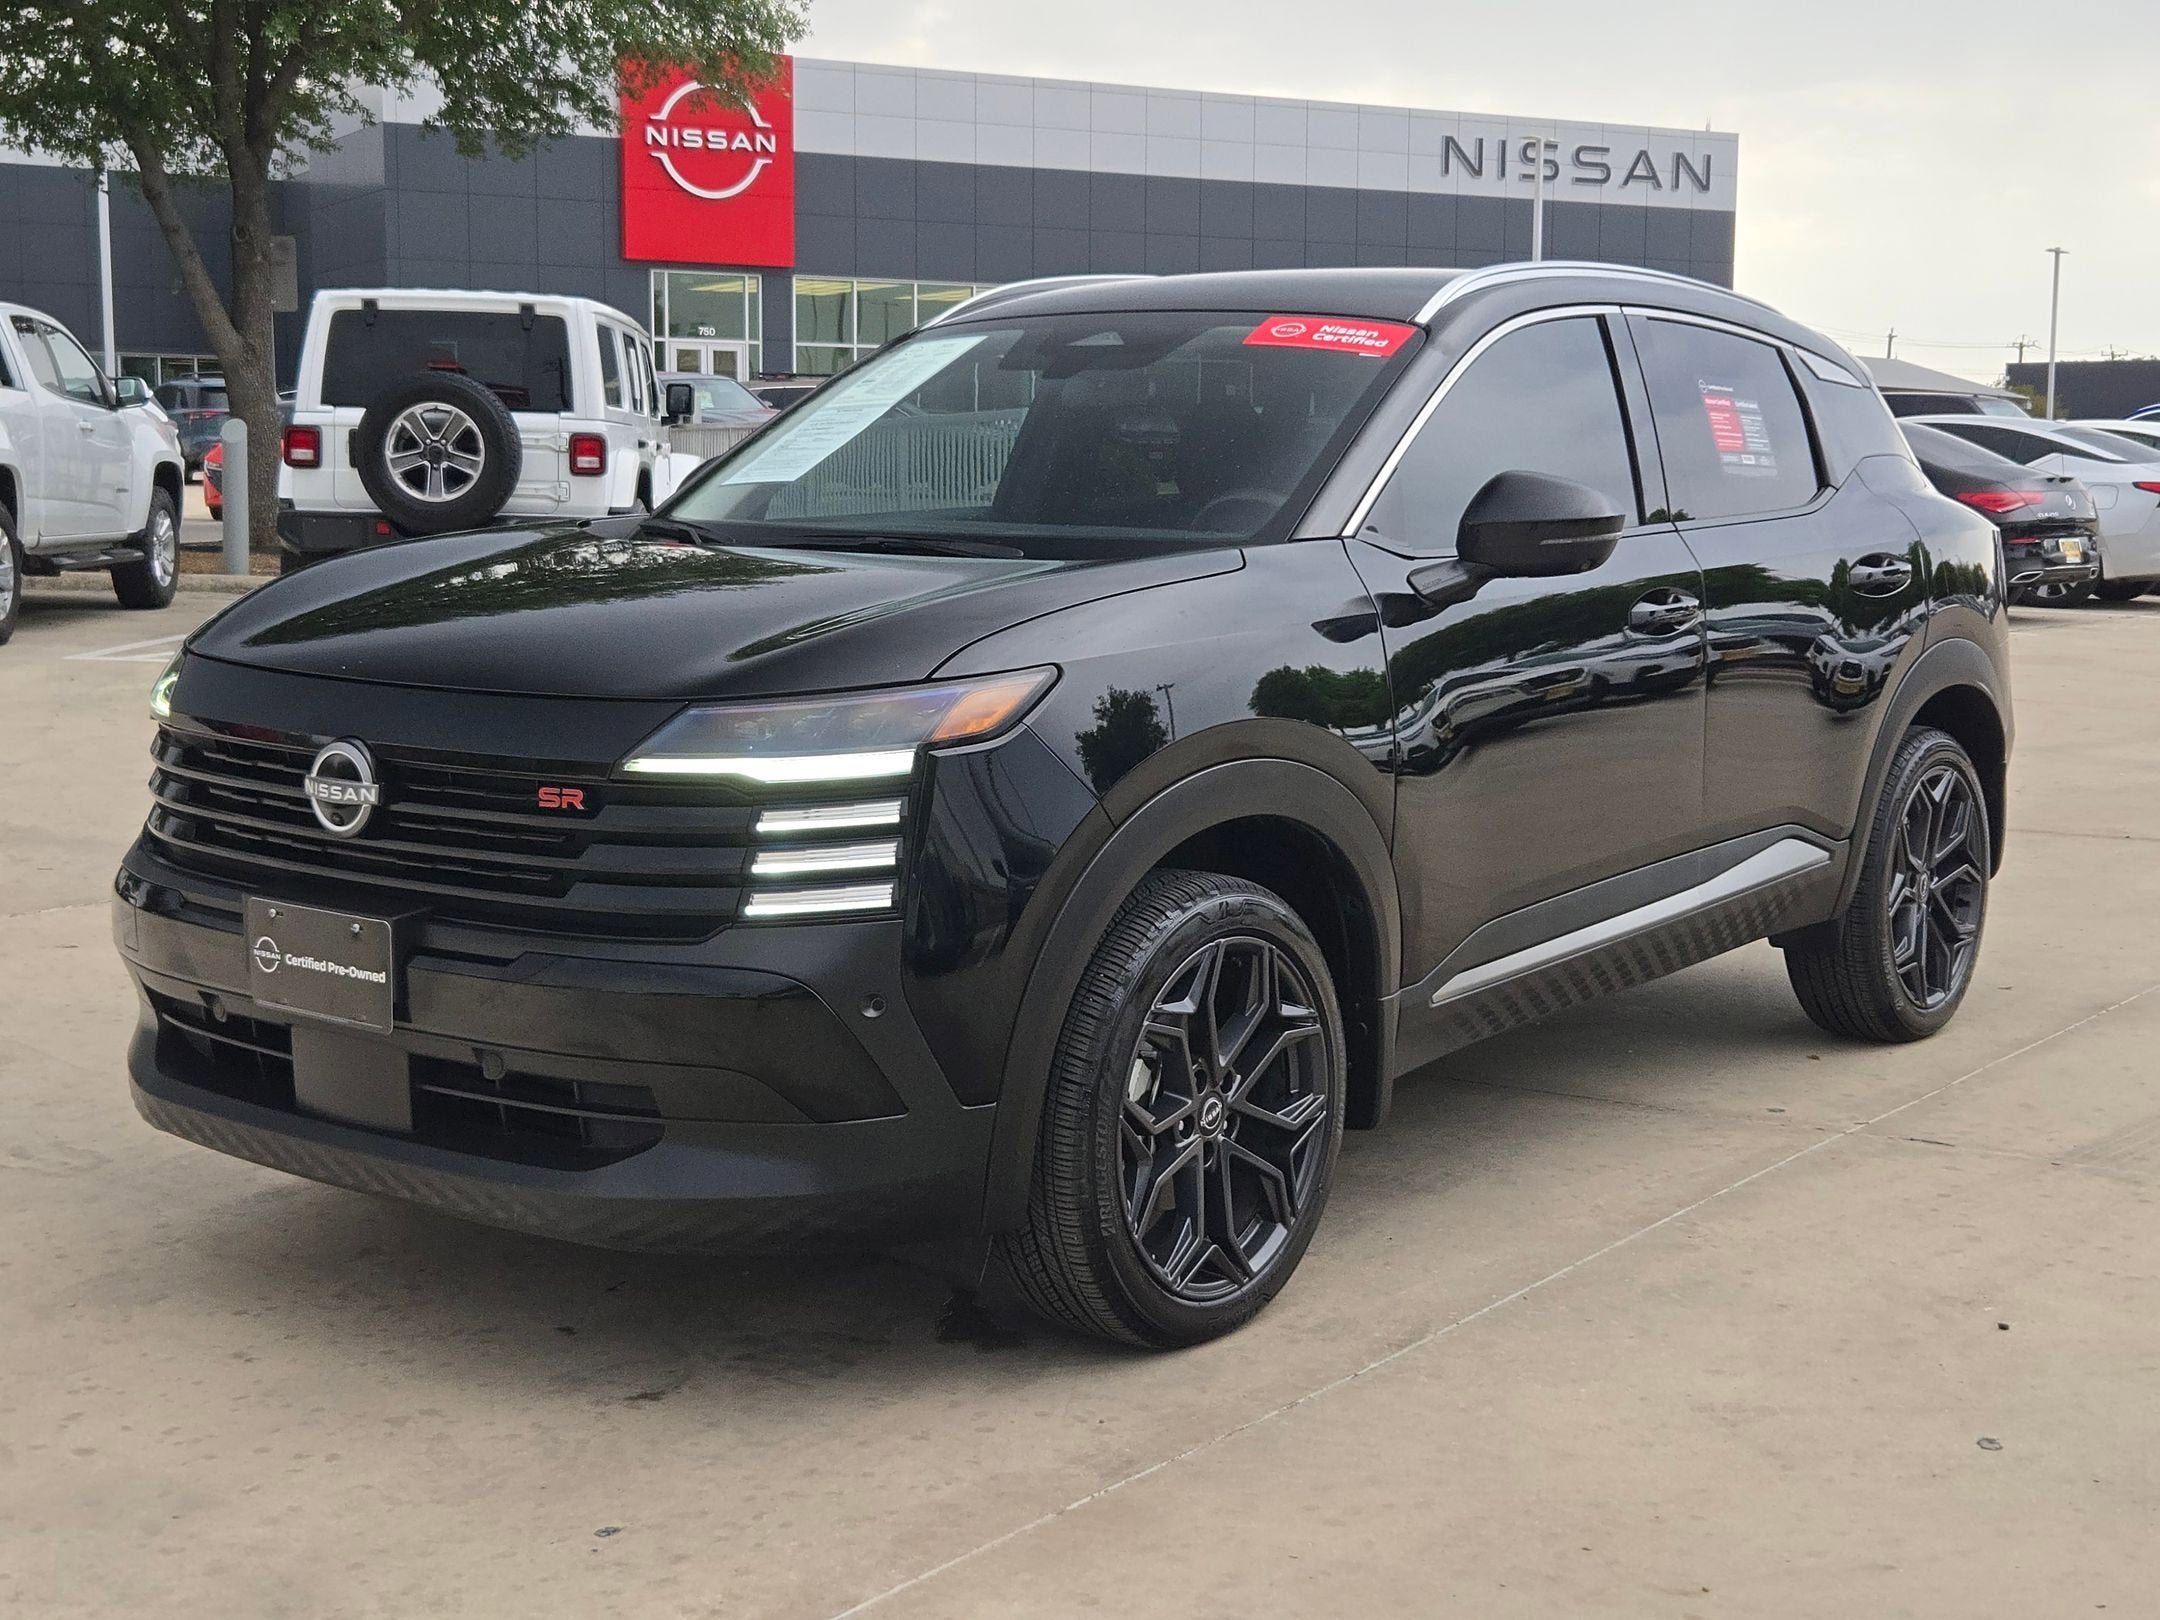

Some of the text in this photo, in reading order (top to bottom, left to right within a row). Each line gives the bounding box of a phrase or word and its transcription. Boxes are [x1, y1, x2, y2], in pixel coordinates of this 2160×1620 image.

[646, 127, 776, 153] NISSAN
[1441, 135, 1711, 193] NISSAN
[698, 327, 716, 336] 750
[1312, 332, 1388, 347] Certified
[1320, 325, 1378, 337] Nissan
[305, 780, 377, 802] NISSAN
[538, 787, 585, 810] SR
[254, 949, 281, 960] NISSAN
[286, 954, 386, 984] Certified Pre-Owned
